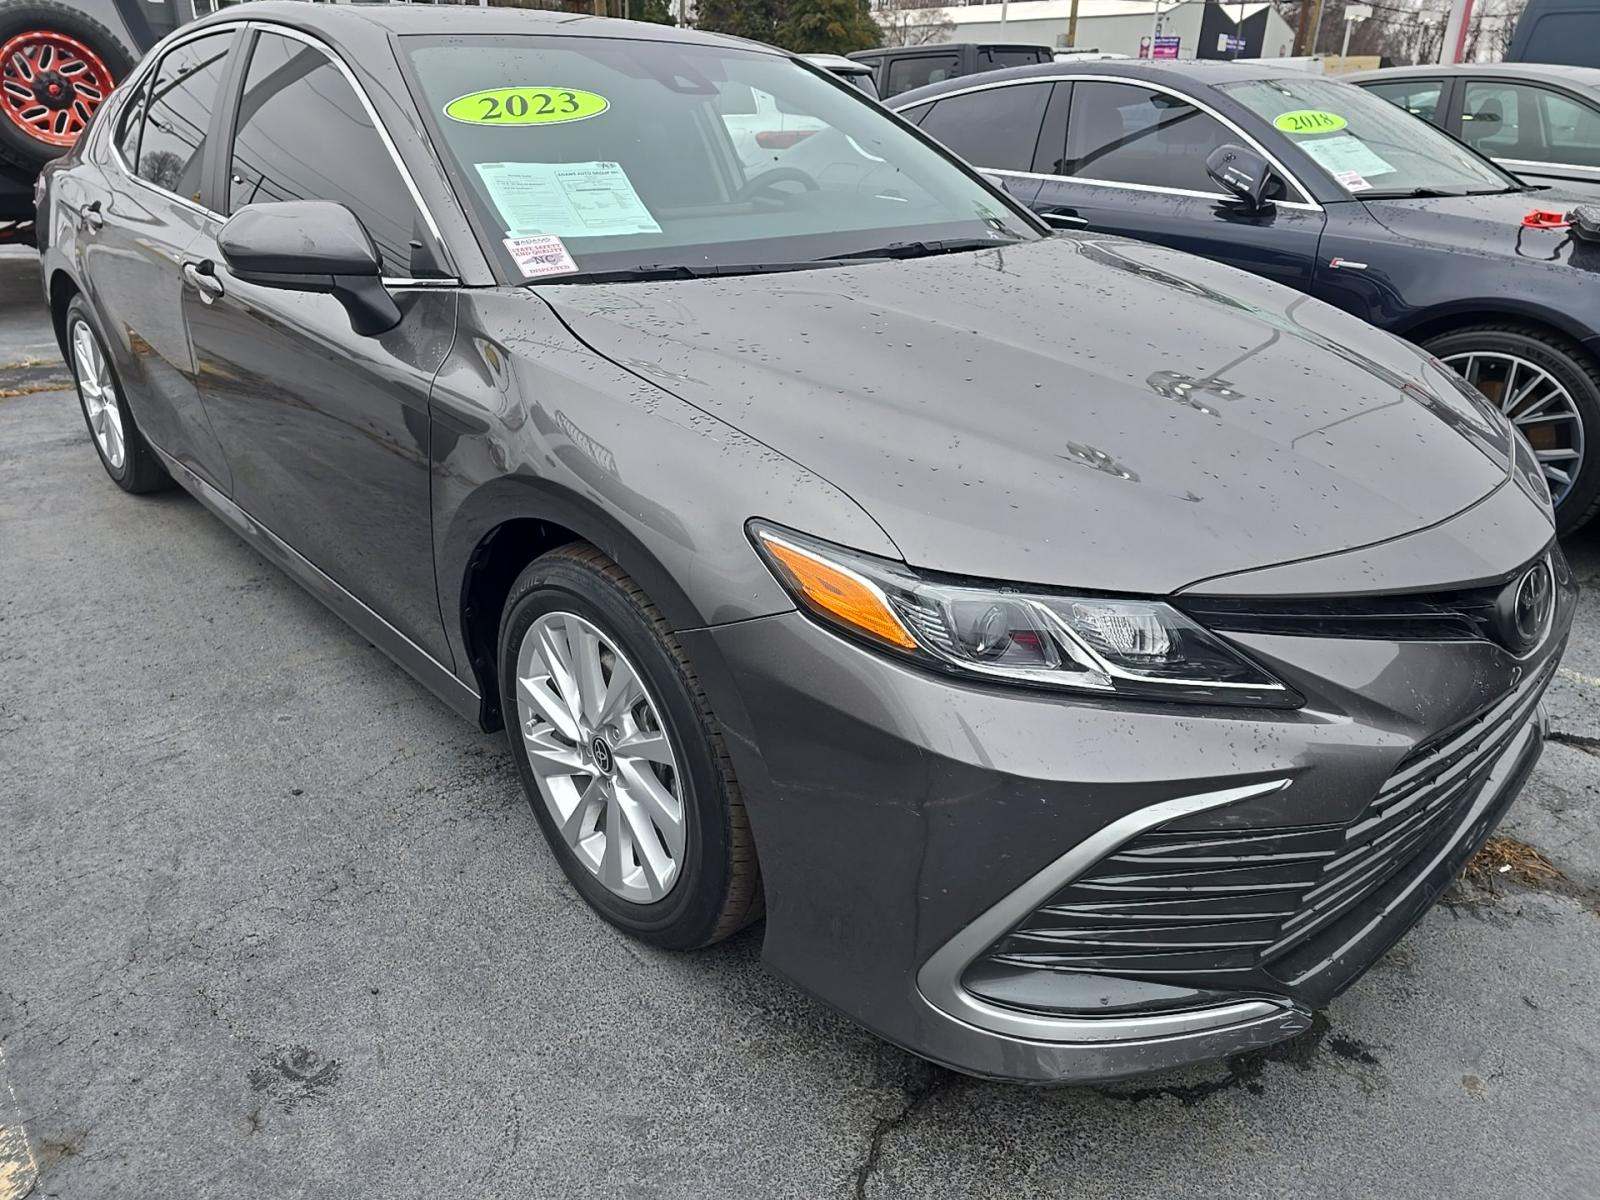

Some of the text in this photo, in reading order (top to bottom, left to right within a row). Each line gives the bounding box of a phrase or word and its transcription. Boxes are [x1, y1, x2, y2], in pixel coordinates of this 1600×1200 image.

[478, 92, 580, 120] 2023
[1287, 112, 1335, 130] 2018
[532, 247, 562, 255] QUALITY
[534, 254, 557, 265] NC
[529, 265, 570, 274] INSPECTED
